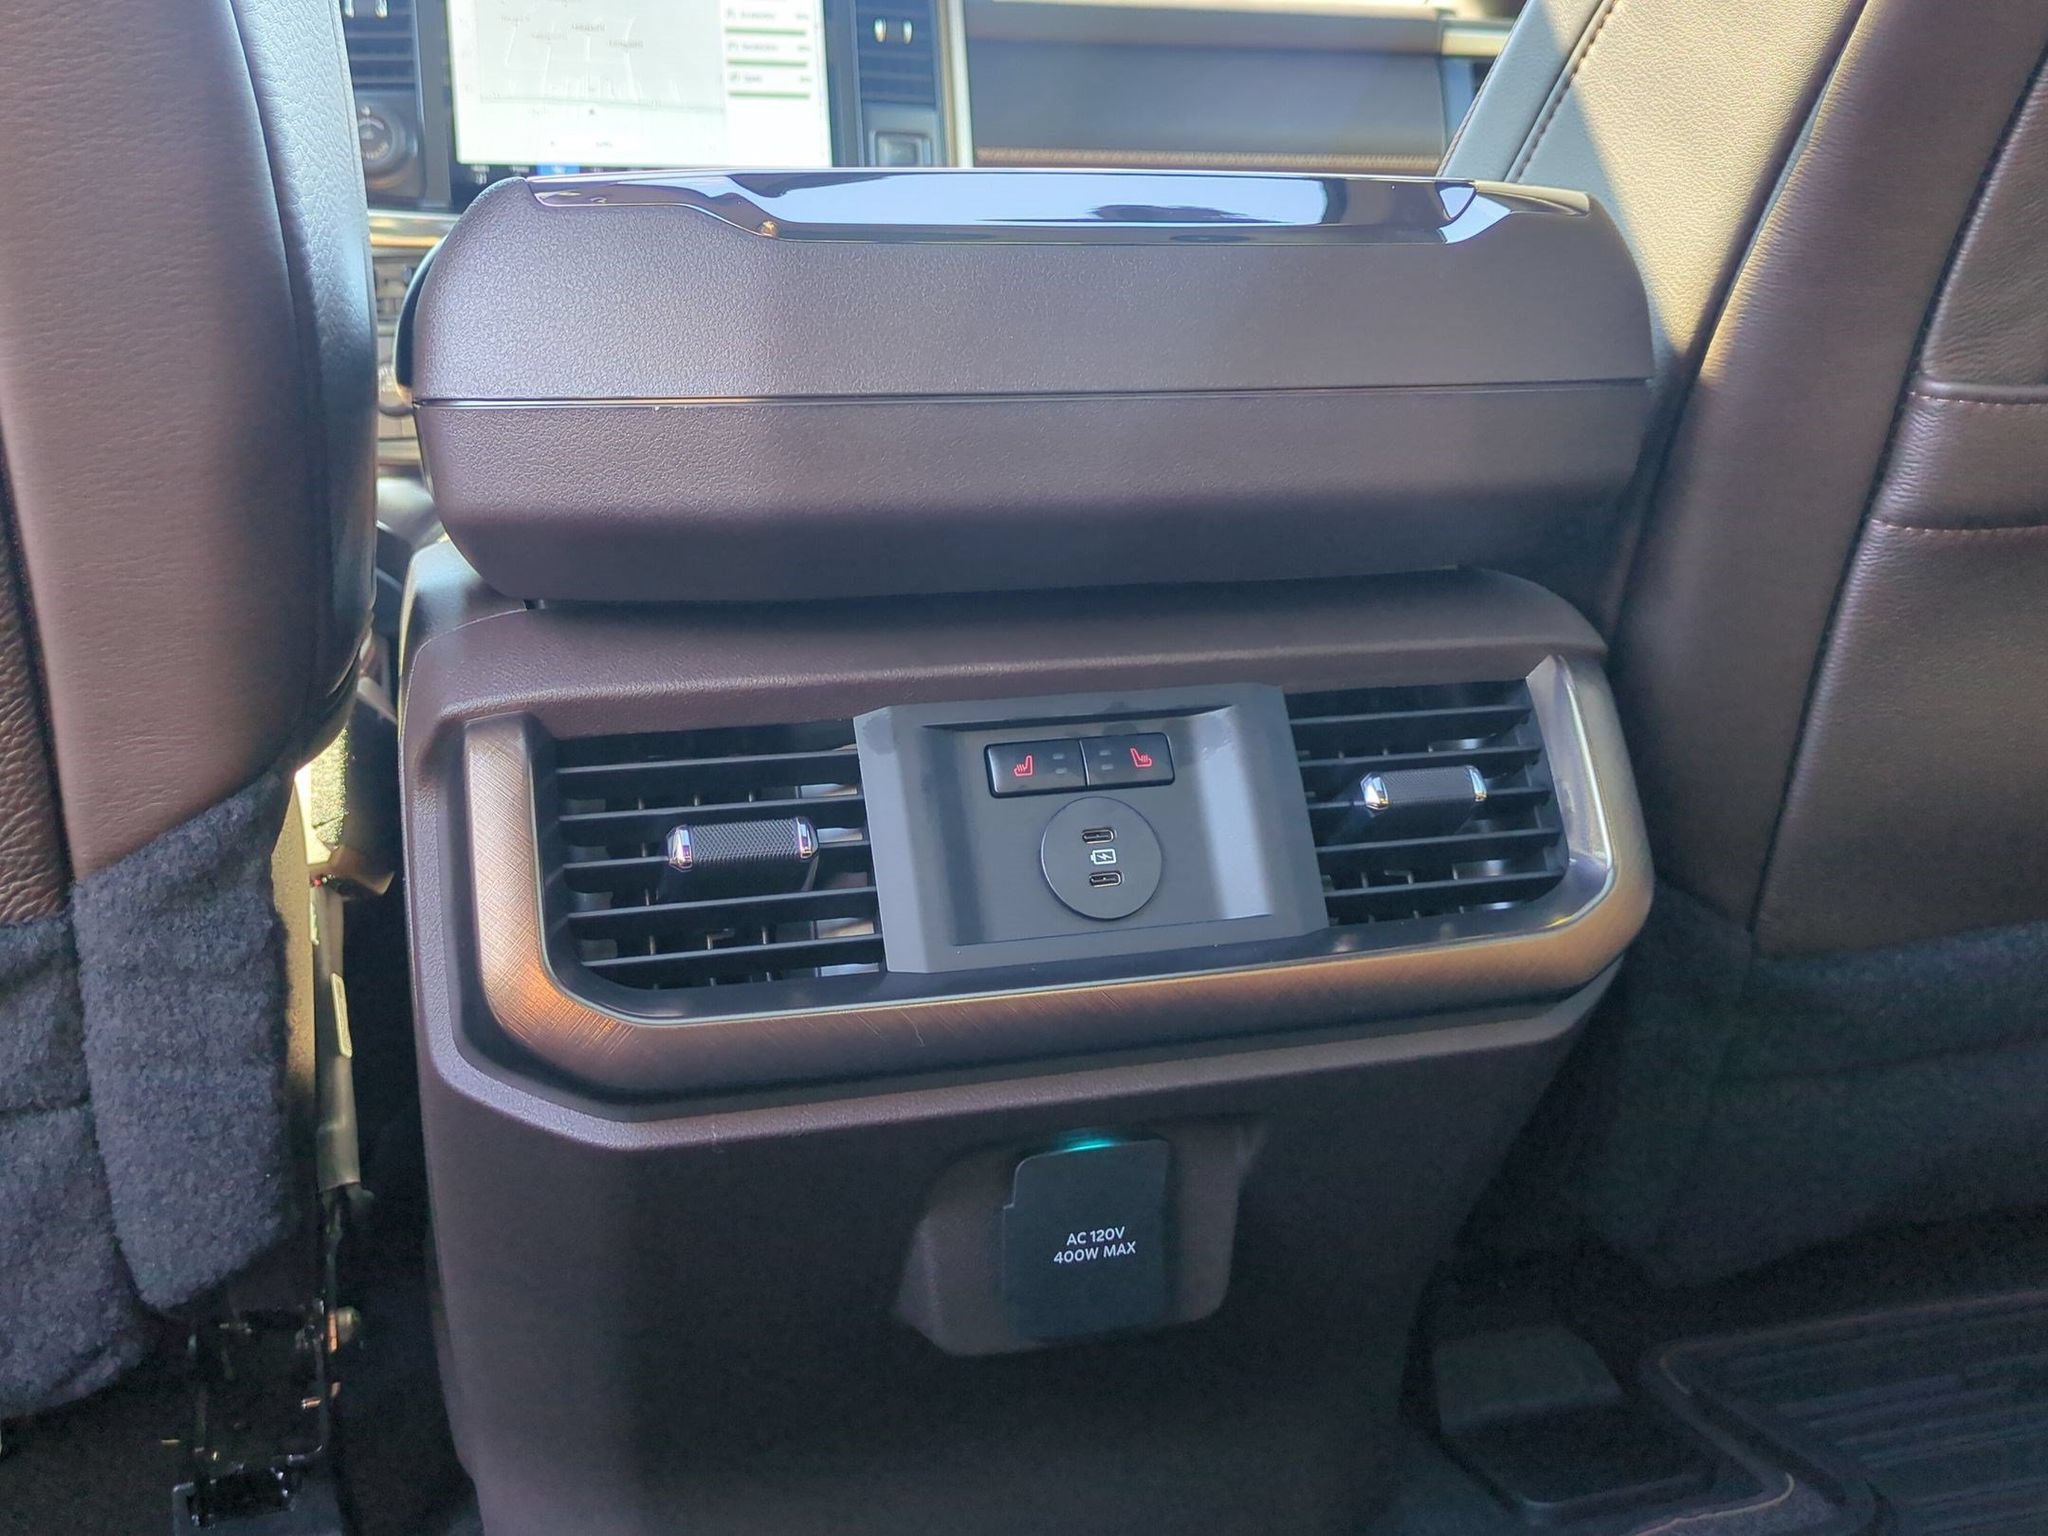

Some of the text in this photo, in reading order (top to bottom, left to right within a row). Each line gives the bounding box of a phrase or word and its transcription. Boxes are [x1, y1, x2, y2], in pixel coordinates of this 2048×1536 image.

[1066, 1226, 1125, 1246] AC 120V
[1053, 1240, 1136, 1264] 400W MAX
